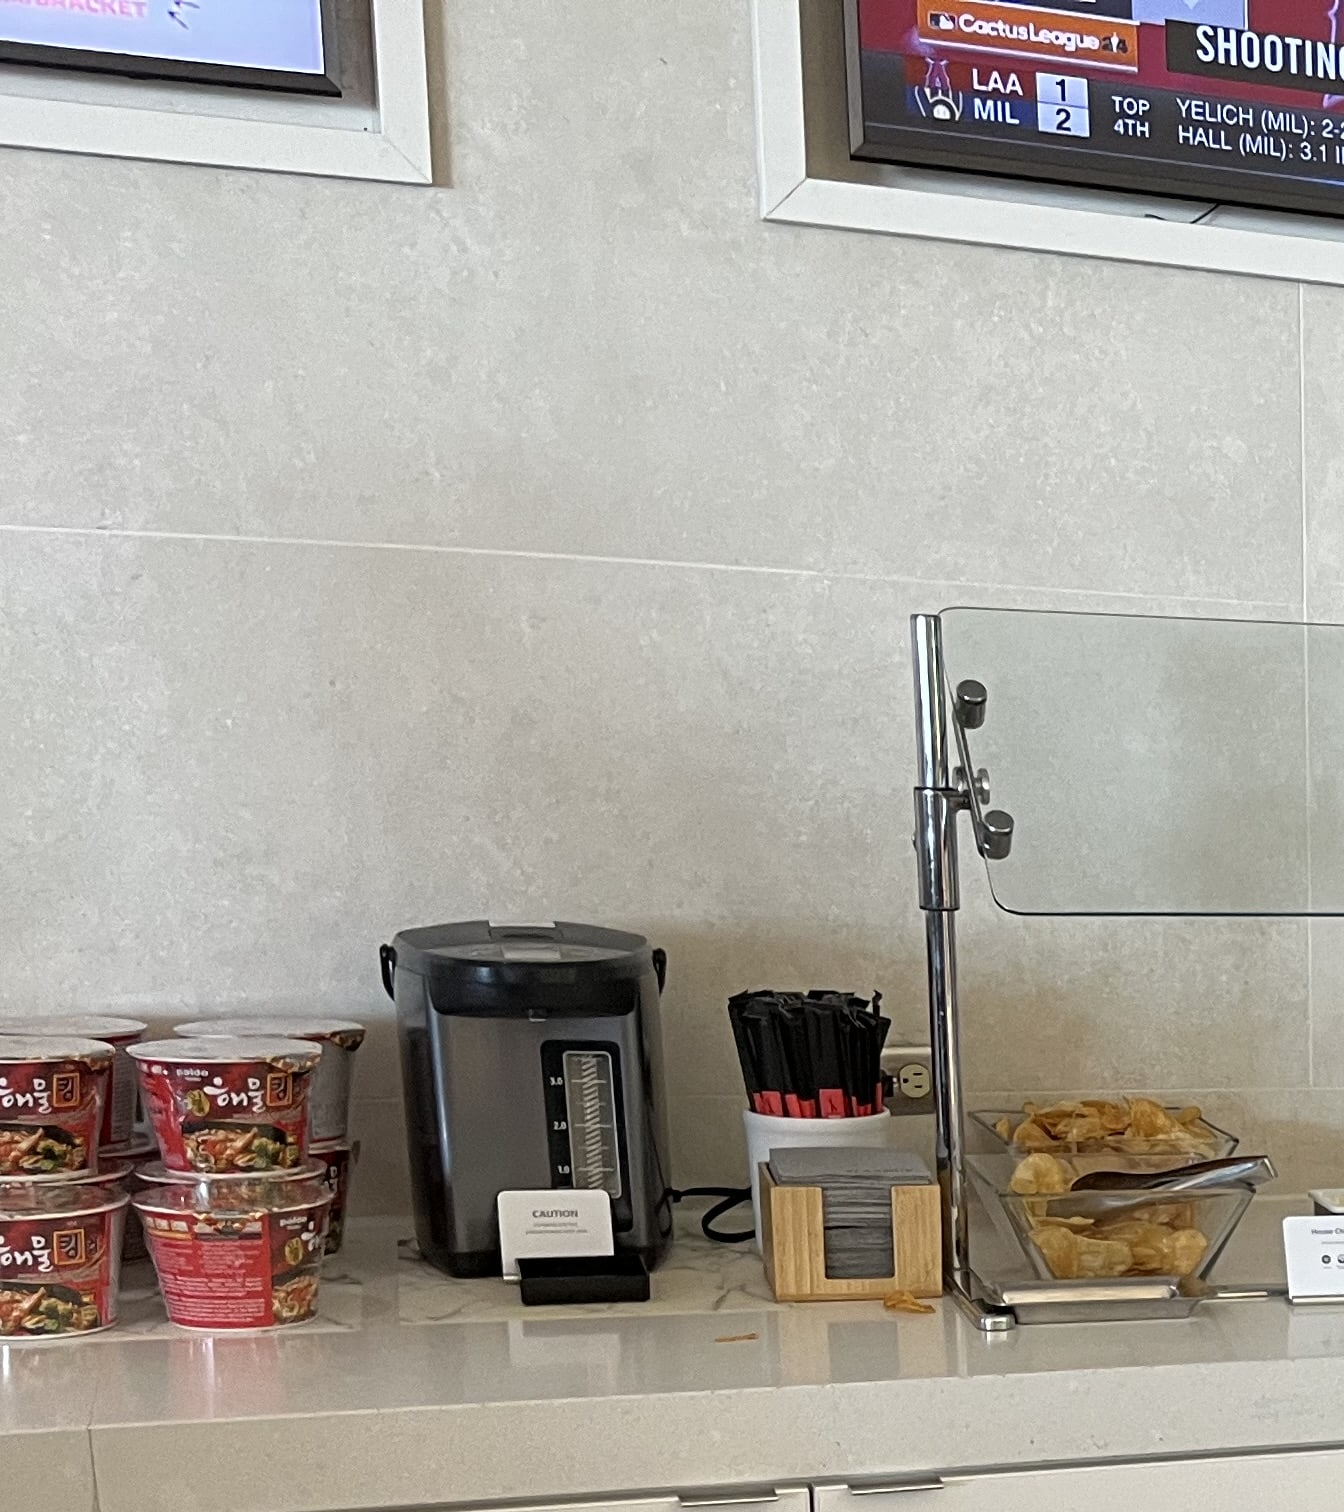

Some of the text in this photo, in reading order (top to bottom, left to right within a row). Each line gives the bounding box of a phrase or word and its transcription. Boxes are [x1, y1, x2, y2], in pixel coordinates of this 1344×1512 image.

[972, 68, 1067, 102] LAA 1
[974, 98, 1071, 132] MIL 2
[1111, 95, 1150, 116] TOP
[1177, 98, 1253, 127] YELICH
[1261, 110, 1316, 139] (MIL):
[1113, 118, 1150, 138] 4TH
[1178, 125, 1232, 151] HALL
[1239, 132, 1294, 161] (MIL):
[1300, 142, 1327, 163] 3.1
[532, 1210, 579, 1219] CAUTION
